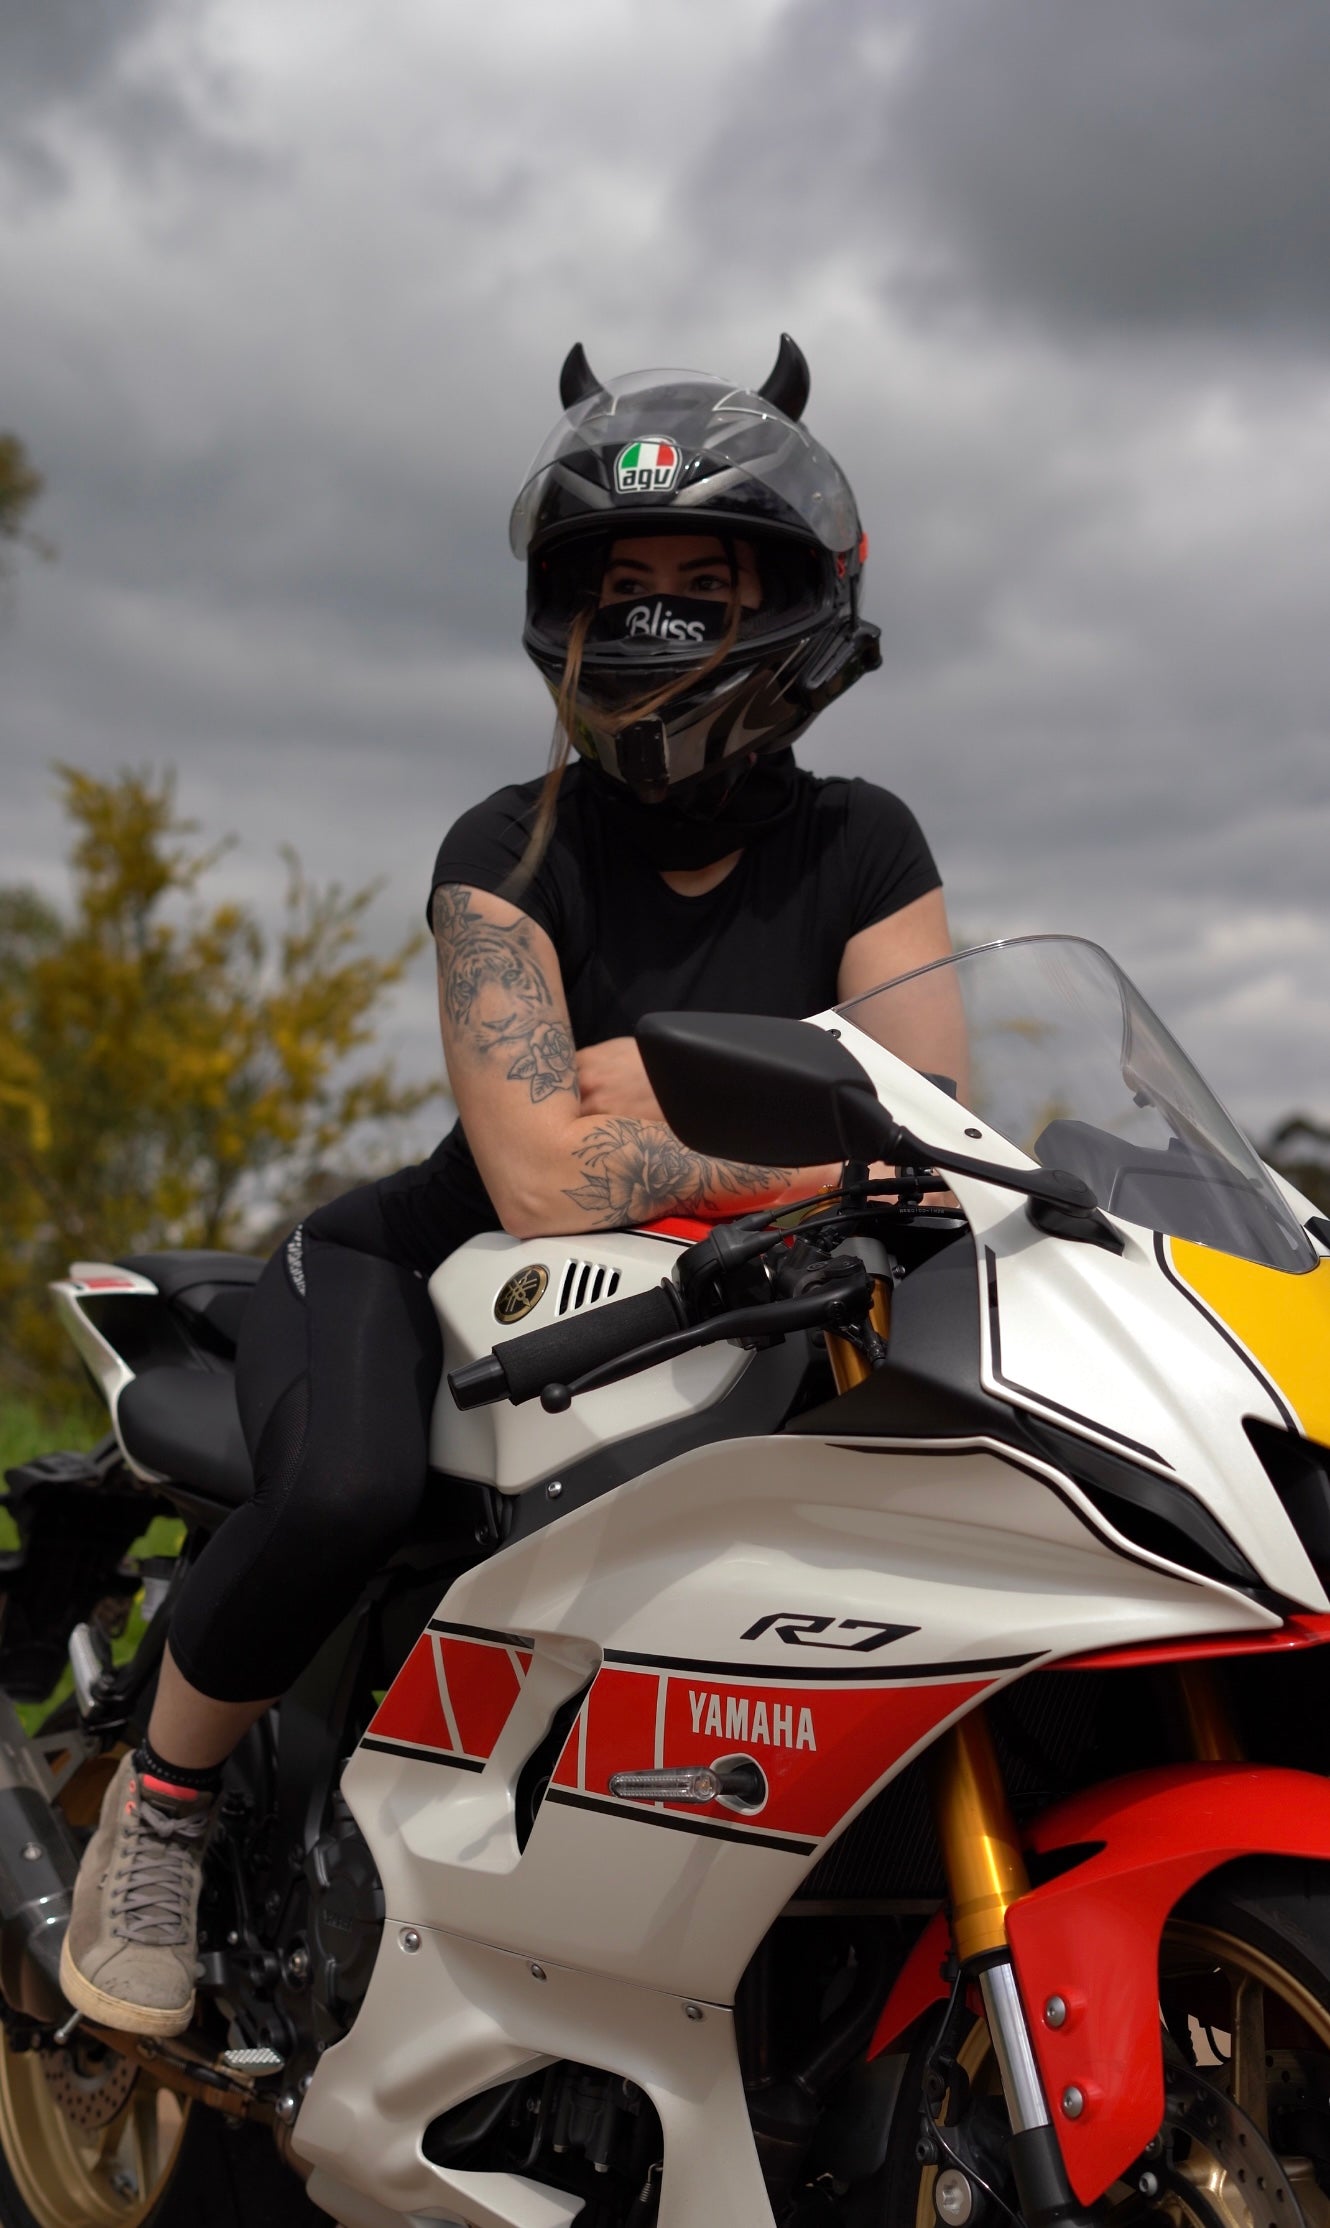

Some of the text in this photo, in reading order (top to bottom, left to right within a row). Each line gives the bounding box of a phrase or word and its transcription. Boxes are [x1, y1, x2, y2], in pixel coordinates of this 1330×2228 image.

[622, 468, 671, 490] agv
[626, 601, 705, 642] Bliss
[740, 1613, 922, 1652] R7
[688, 1690, 817, 1751] YAMAHA
